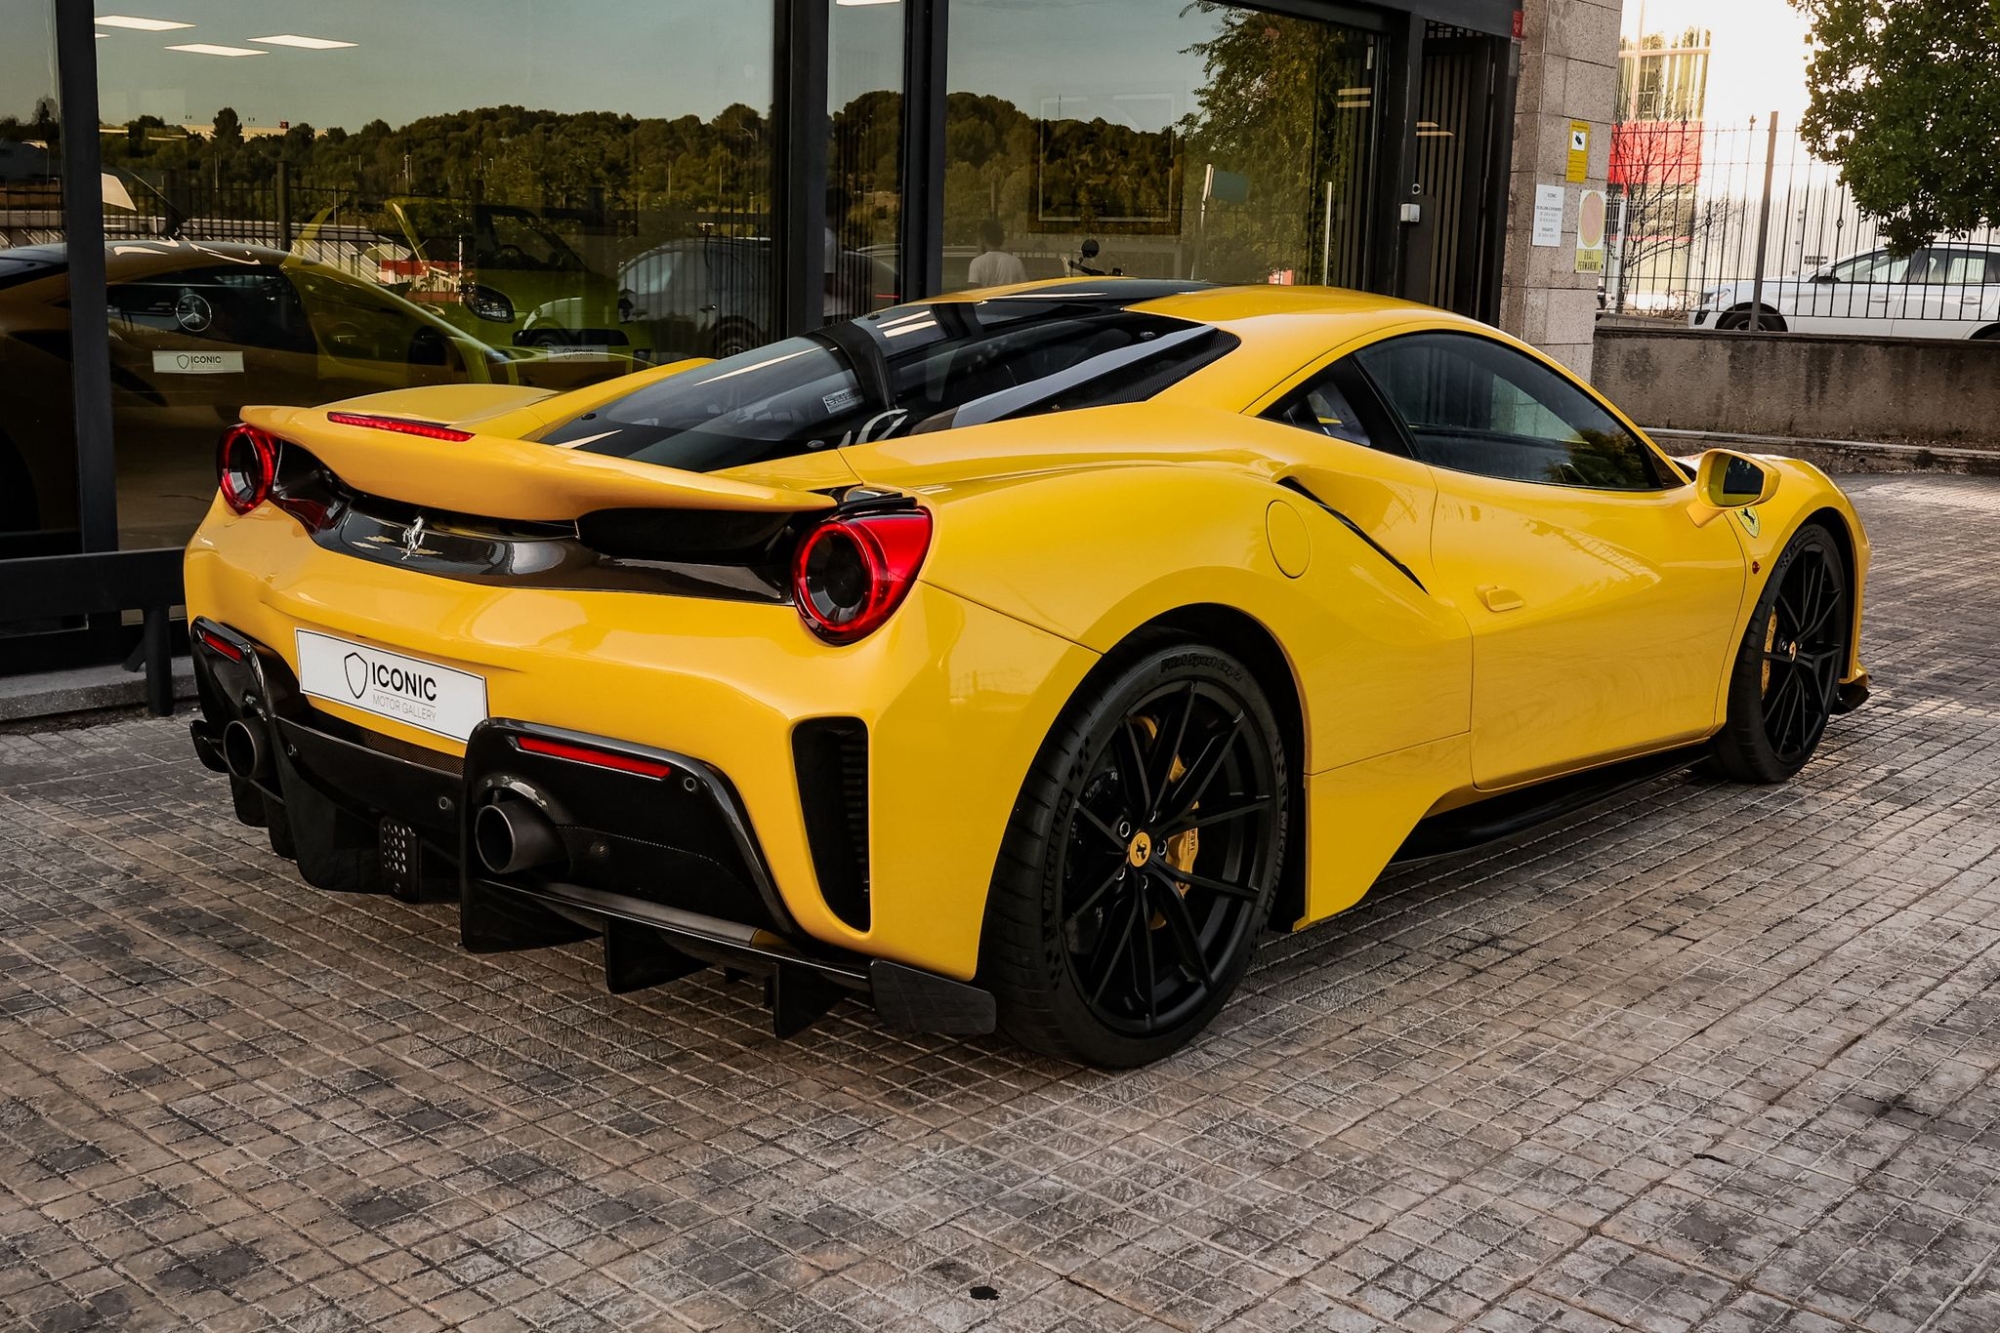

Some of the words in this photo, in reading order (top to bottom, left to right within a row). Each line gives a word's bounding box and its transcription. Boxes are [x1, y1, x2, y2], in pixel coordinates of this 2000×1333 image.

[191, 355, 222, 364] ICONIC
[1188, 653, 1218, 667] Sport
[372, 662, 437, 701] ICONIC
[372, 694, 401, 711] MOTOR
[401, 702, 437, 722] GALLERY
